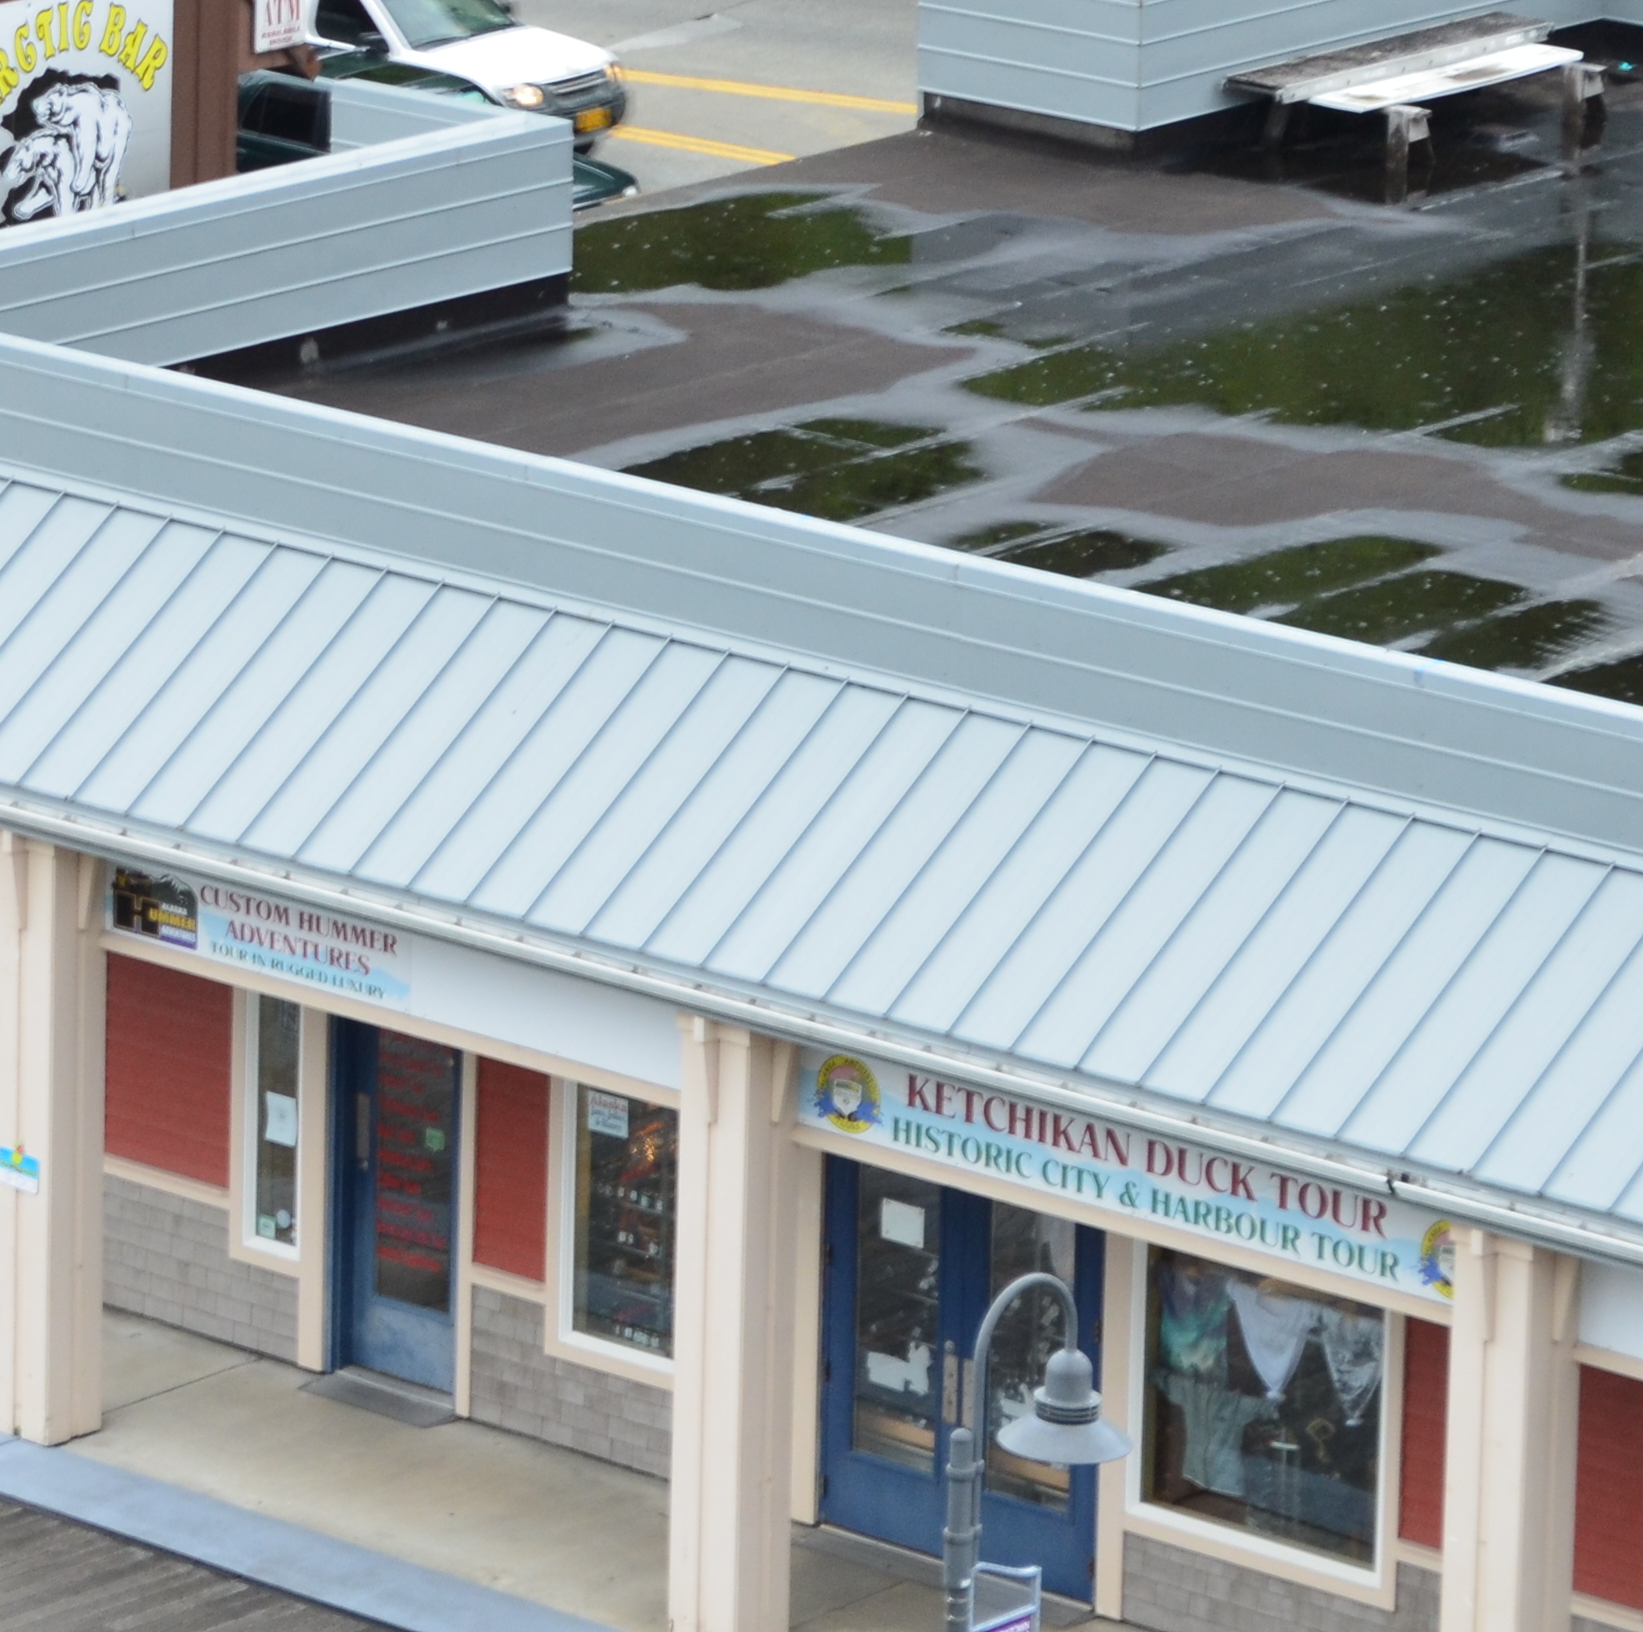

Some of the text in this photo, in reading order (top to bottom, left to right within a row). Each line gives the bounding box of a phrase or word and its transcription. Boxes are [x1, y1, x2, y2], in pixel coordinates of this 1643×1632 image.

[99, 2, 168, 92] BAR
[199, 884, 399, 957] CUSTOM HUMMER
[225, 920, 371, 977] ADVENTURES
[210, 941, 387, 1000] TOUR IN RUGGED LUXURY
[907, 1073, 1130, 1166] KETCHIKAN
[1146, 1138, 1258, 1202] DUCK
[1269, 1172, 1388, 1240] TOUR
[892, 1116, 1032, 1179] HISTORIC
[1042, 1158, 1110, 1202] CITY
[1119, 1181, 1140, 1210] &
[1150, 1188, 1301, 1255] HARBOUR
[1312, 1231, 1400, 1283] TOUR
